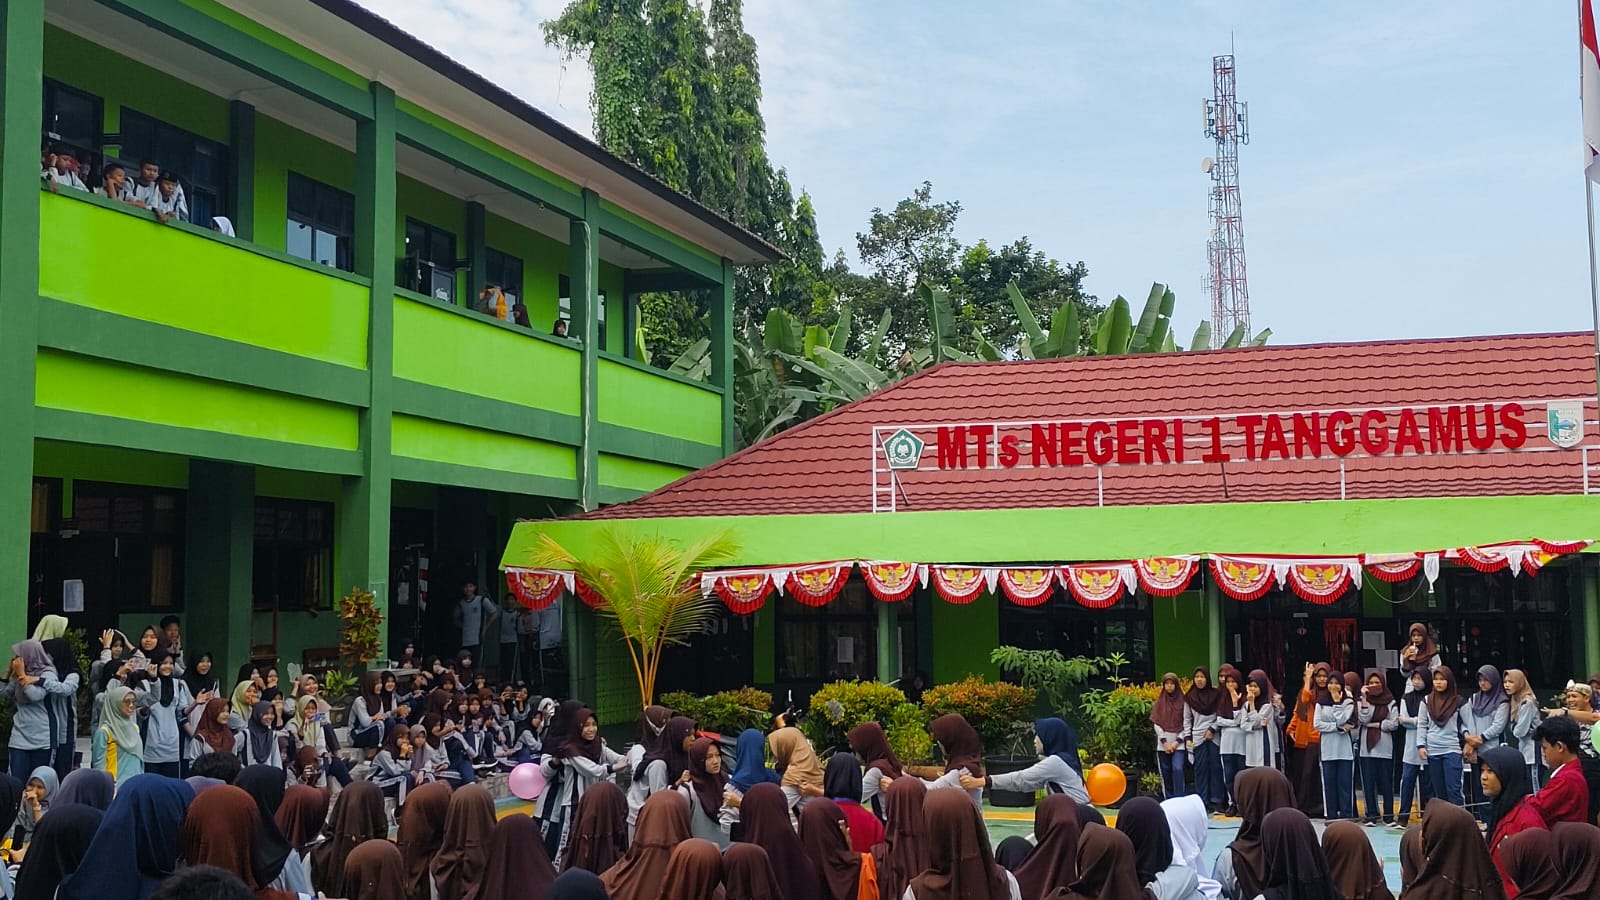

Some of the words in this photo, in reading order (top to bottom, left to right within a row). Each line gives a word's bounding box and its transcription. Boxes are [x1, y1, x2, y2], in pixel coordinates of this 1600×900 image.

[937, 425, 1019, 469] MTs
[1033, 419, 1183, 466] NEGERI
[1202, 417, 1230, 462] 1
[1237, 403, 1527, 460] TANGGAMUS
